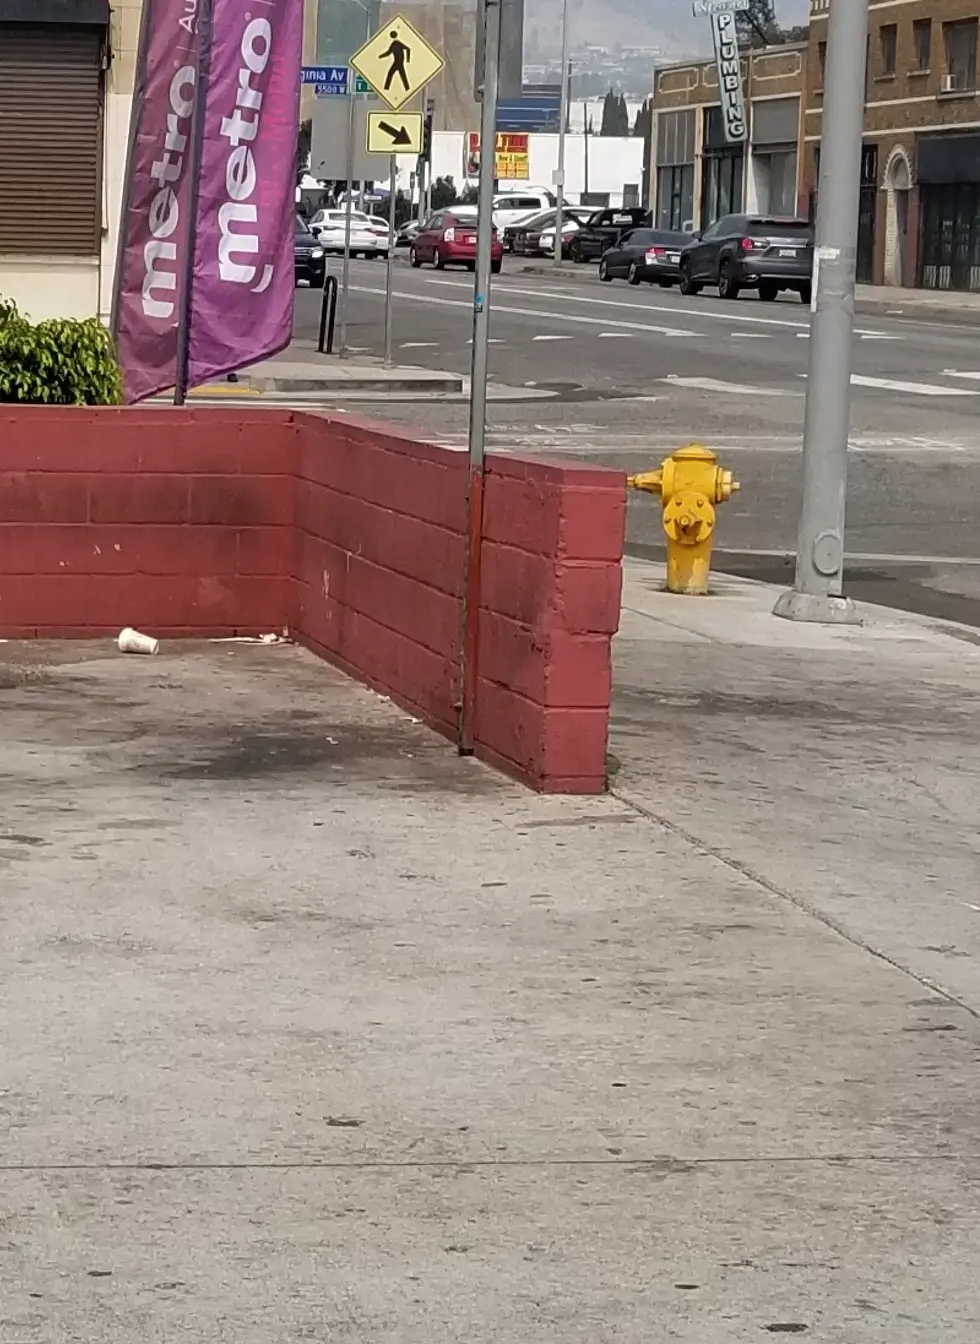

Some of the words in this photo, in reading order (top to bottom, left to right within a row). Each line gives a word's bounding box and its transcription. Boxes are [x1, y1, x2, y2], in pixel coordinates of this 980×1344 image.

[218, 16, 273, 284] metro
[301, 70, 326, 83] ginia
[330, 69, 345, 81] Av
[718, 14, 745, 139] PLUMBING
[141, 63, 197, 319] metro
